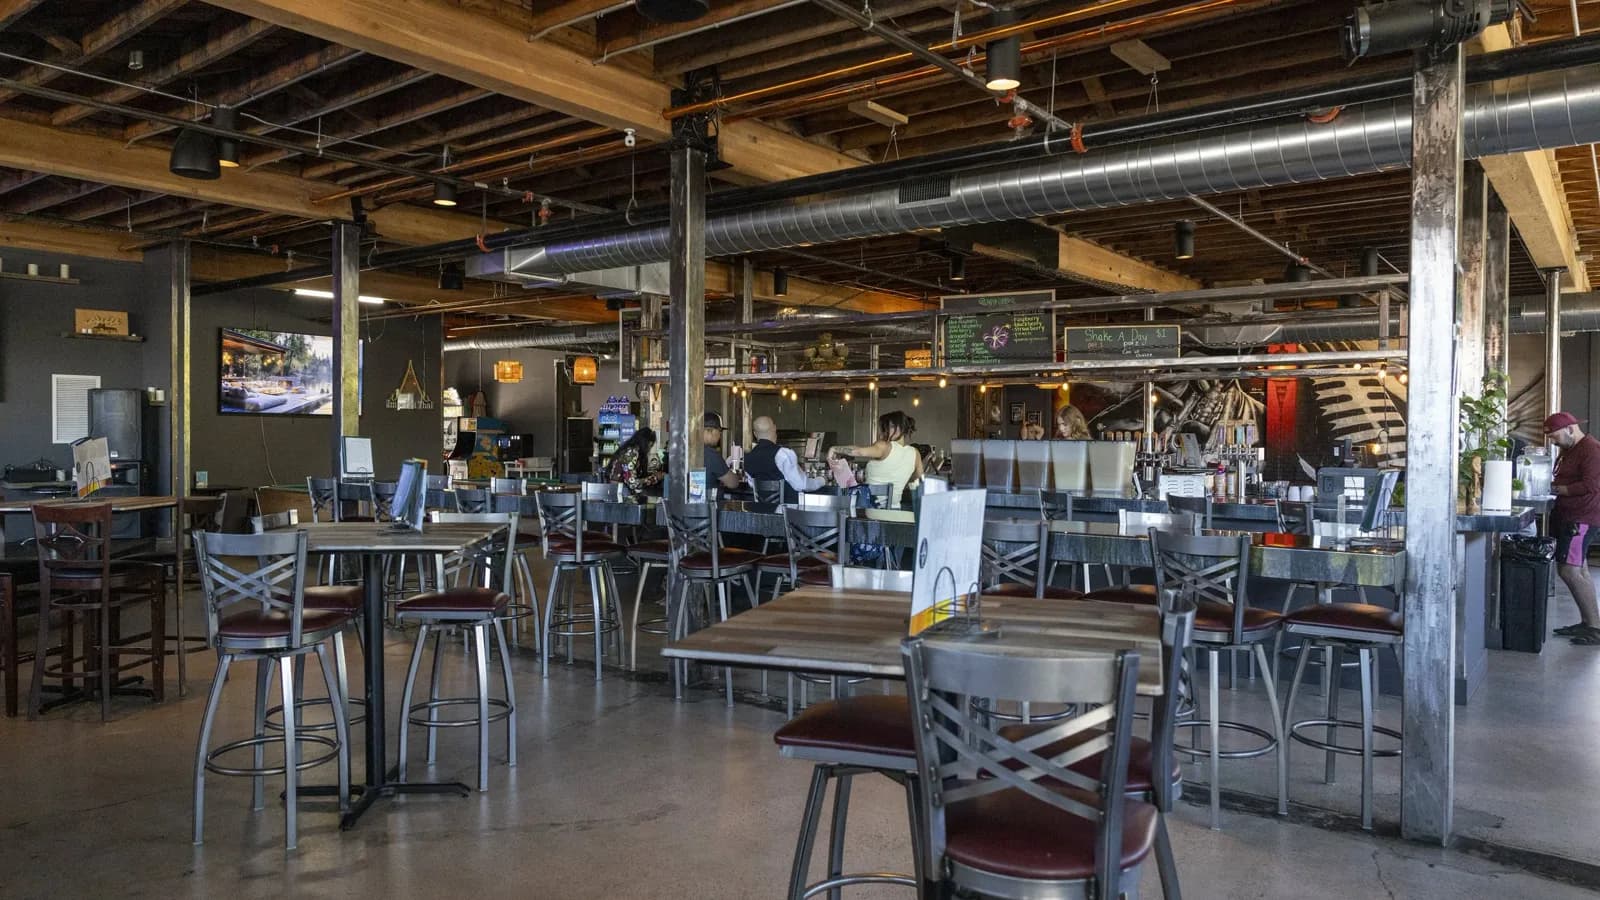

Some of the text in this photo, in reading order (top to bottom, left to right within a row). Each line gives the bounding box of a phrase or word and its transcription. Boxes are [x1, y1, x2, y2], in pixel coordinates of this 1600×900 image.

[1085, 328, 1167, 344] Shake A Day $1
